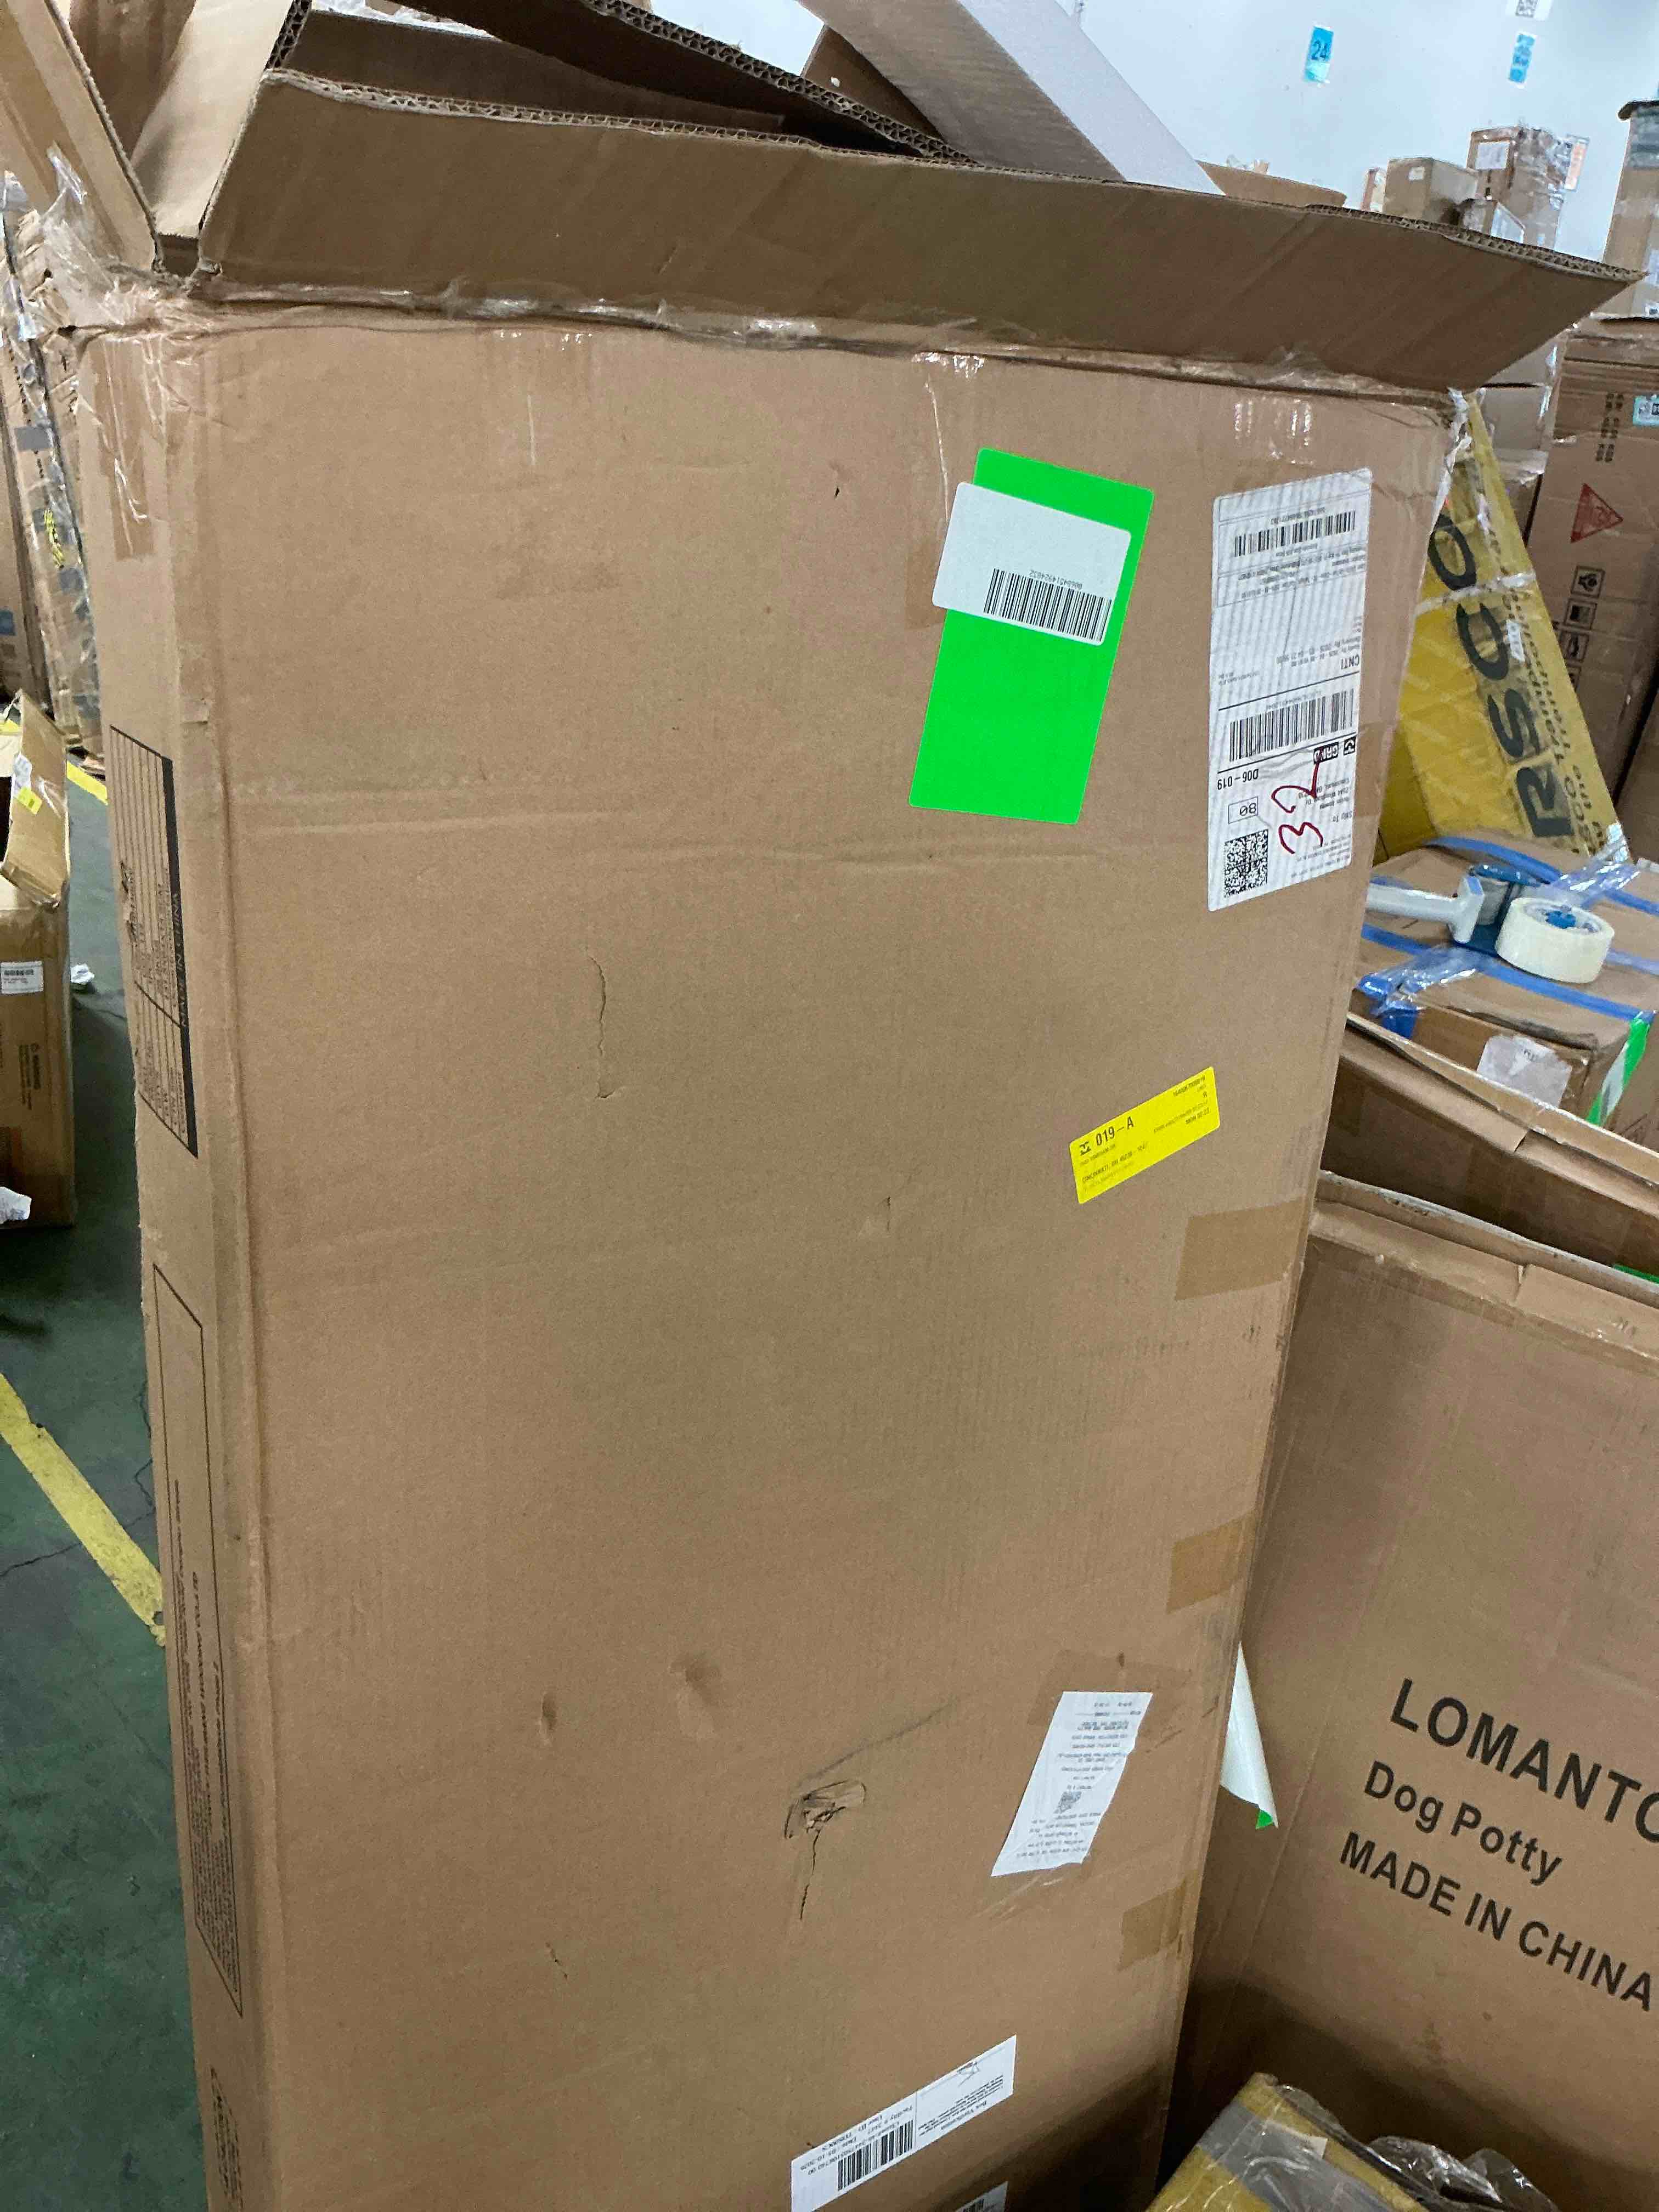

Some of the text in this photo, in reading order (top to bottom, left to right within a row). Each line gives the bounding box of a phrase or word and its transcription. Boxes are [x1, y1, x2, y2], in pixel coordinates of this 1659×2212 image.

[1364, 1760, 1562, 1886] Dog Potty
[1339, 1831, 1651, 2011] MADE IN CHINA
